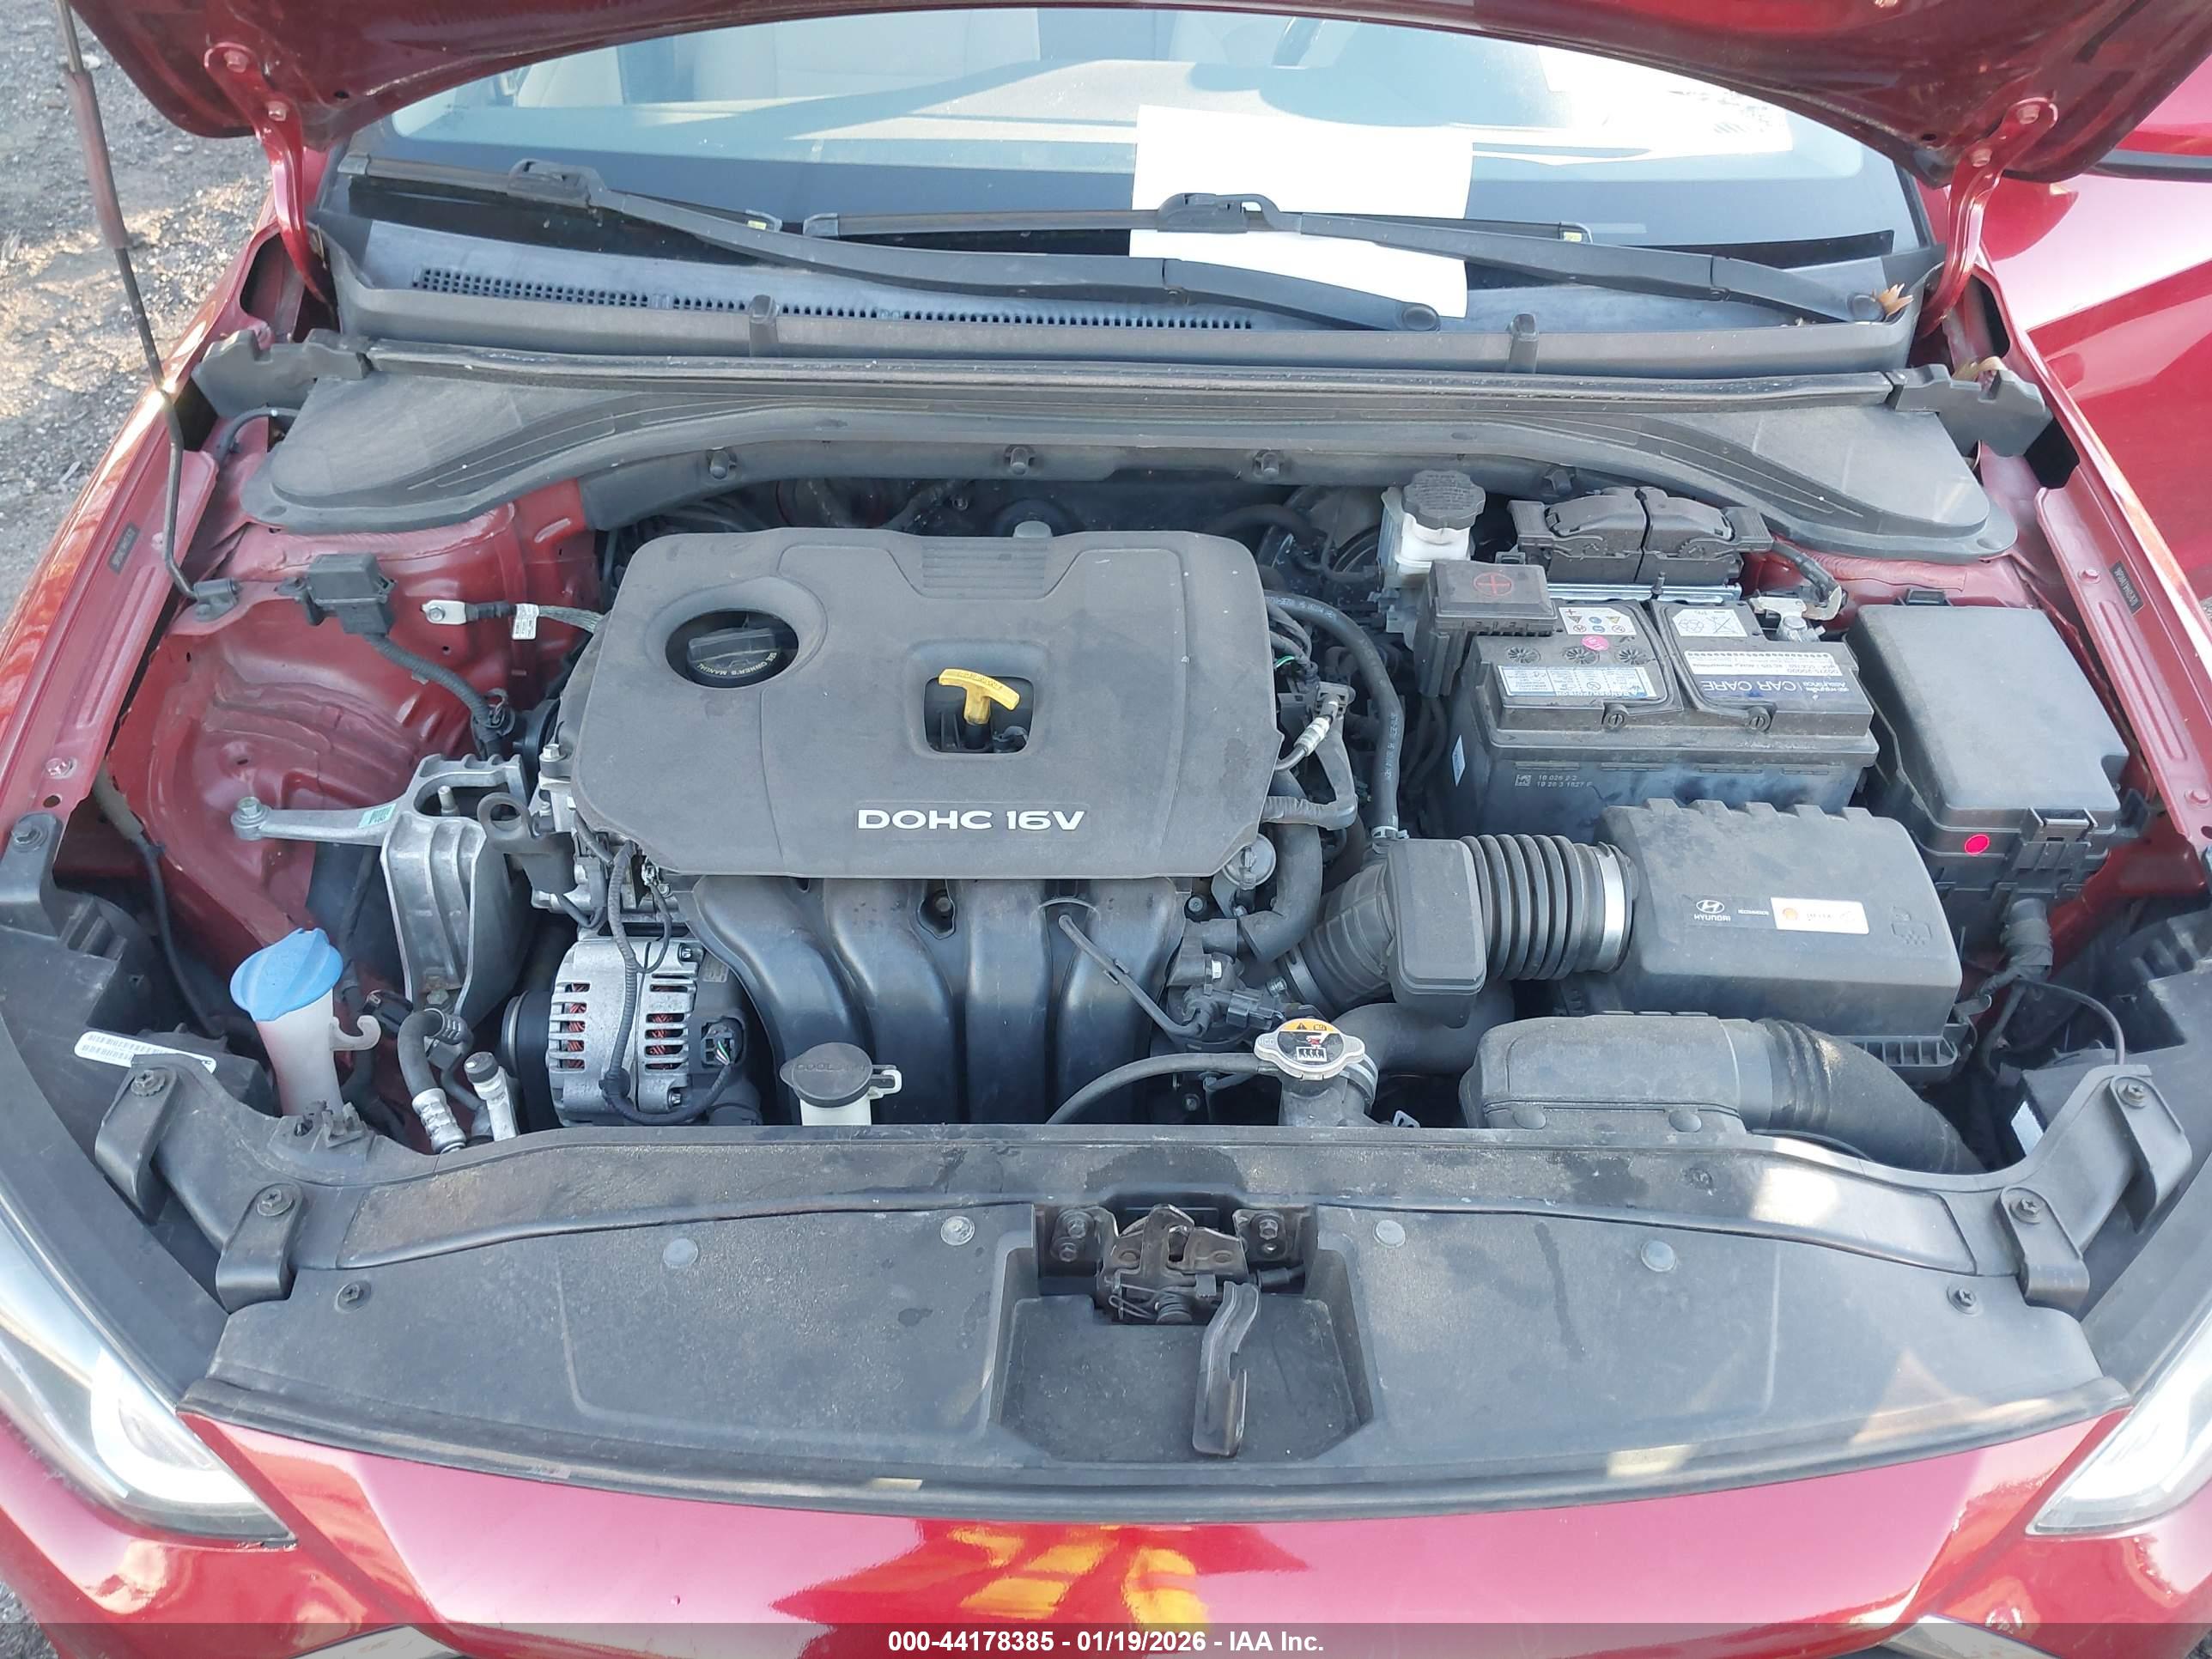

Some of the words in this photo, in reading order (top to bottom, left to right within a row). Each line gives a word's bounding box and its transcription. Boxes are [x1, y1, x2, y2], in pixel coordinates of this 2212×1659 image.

[1700, 681, 1753, 691] CARE
[1757, 681, 1796, 691] CAR
[858, 809, 993, 830] DOHC
[1006, 810, 1085, 830] 16V
[1693, 913, 1732, 921] HYUNDAI
